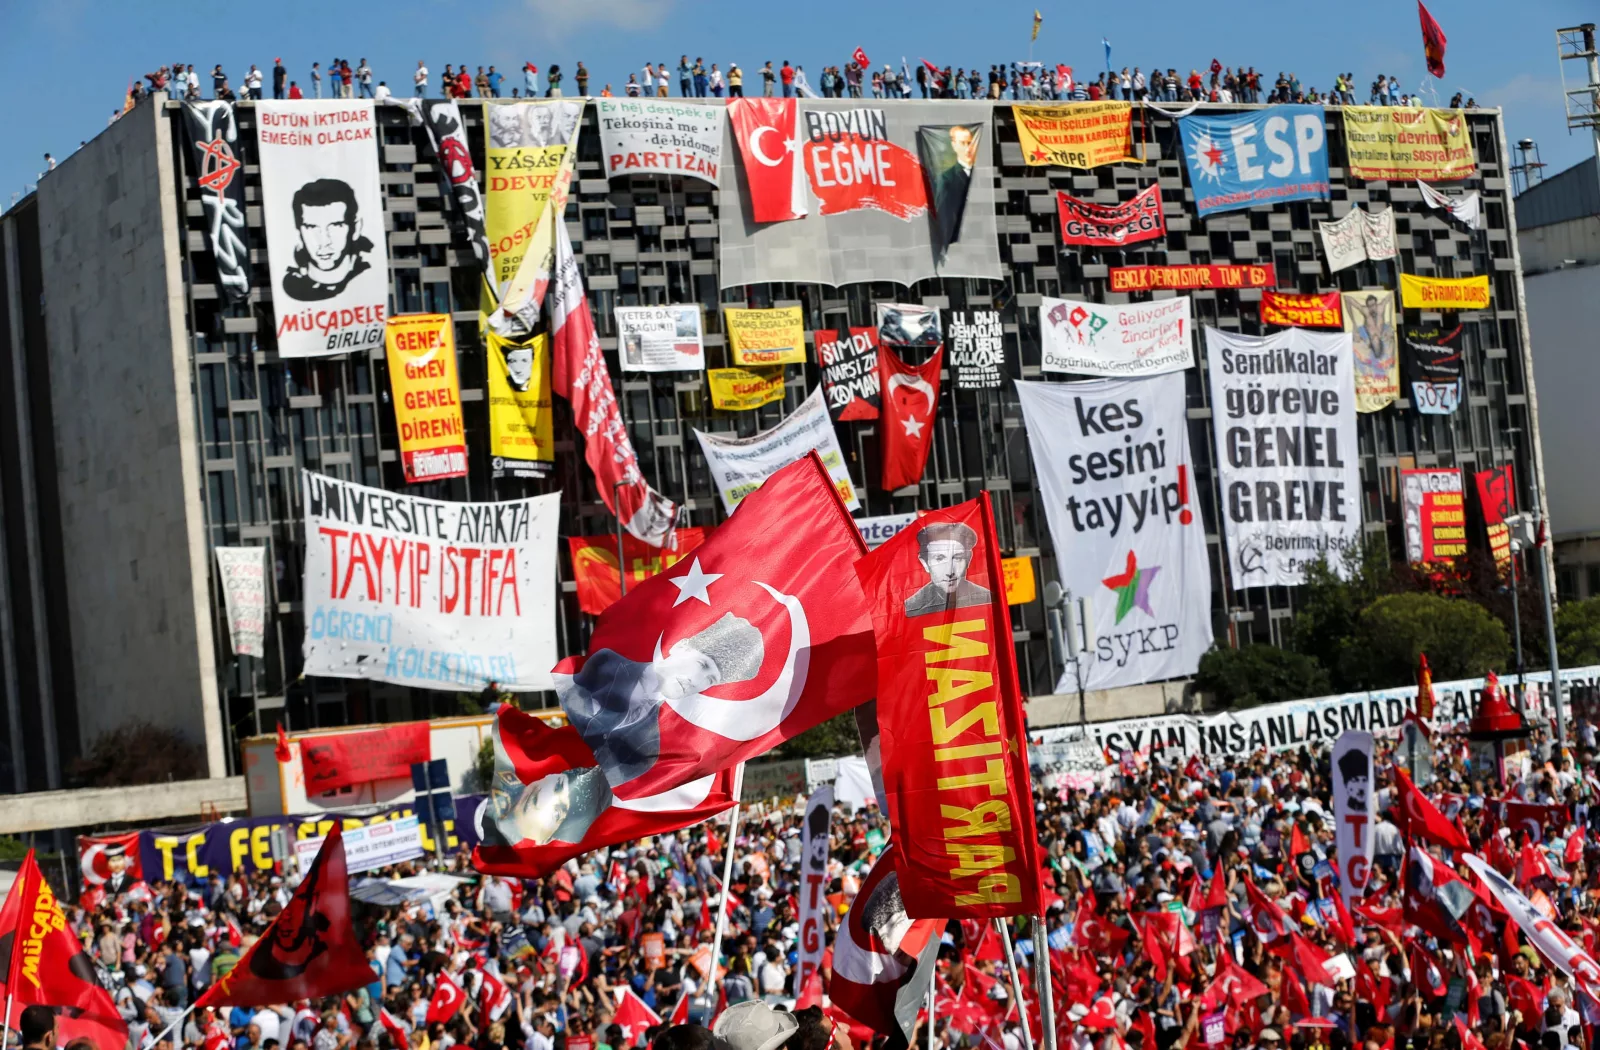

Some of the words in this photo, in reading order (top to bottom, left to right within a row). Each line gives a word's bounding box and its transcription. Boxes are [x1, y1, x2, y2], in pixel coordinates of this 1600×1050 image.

[262, 112, 309, 127] BÜTÜN
[317, 127, 373, 145] OLACAK
[678, 123, 698, 133] me
[804, 109, 888, 143] BOYUN
[811, 141, 896, 187] EĞME
[1053, 149, 1086, 167] TÖPG
[1231, 114, 1324, 182] ESP
[395, 330, 447, 350] GENEL
[821, 331, 873, 366] ŞİMDİ
[405, 359, 446, 380] GREV
[1221, 347, 1338, 376] Sendikalar
[404, 387, 456, 410] GENEL
[1225, 383, 1339, 419] göreve
[1073, 396, 1143, 437] kes
[1068, 428, 1167, 485] sesini
[1225, 426, 1344, 469] GENEL
[1066, 464, 1193, 538] tayyip!
[1228, 480, 1347, 523] GREVE
[456, 502, 529, 544] AYAKTA
[319, 526, 430, 609] TAYYİP
[440, 546, 521, 617] İSTİFA
